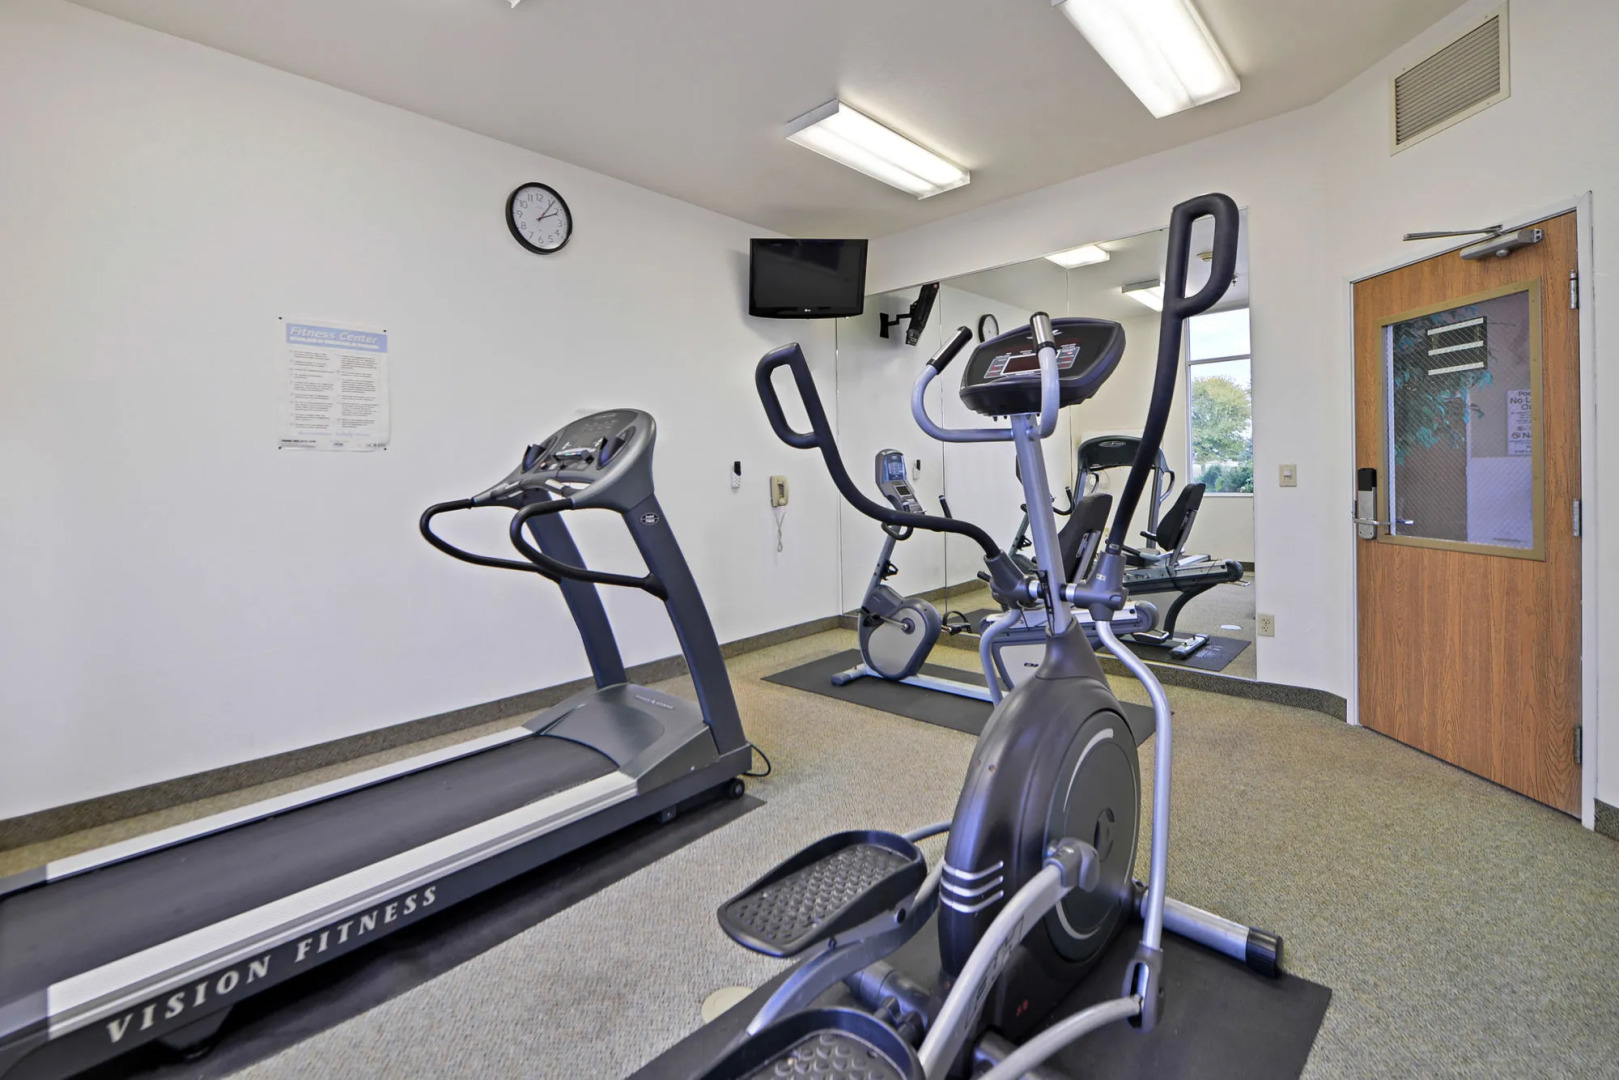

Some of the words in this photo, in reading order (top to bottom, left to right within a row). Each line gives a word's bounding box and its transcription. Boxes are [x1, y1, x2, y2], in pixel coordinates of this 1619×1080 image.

[536, 193, 544, 202] 12
[520, 200, 528, 209] 10
[516, 210, 522, 218] 9
[521, 221, 527, 230] 8
[557, 219, 562, 228] 3
[538, 236, 544, 244] 6
[548, 235, 554, 243] 5
[290, 326, 336, 338] Fitness
[339, 332, 378, 343] Center
[105, 954, 271, 1044] VISION
[294, 886, 437, 964] FITNESS
